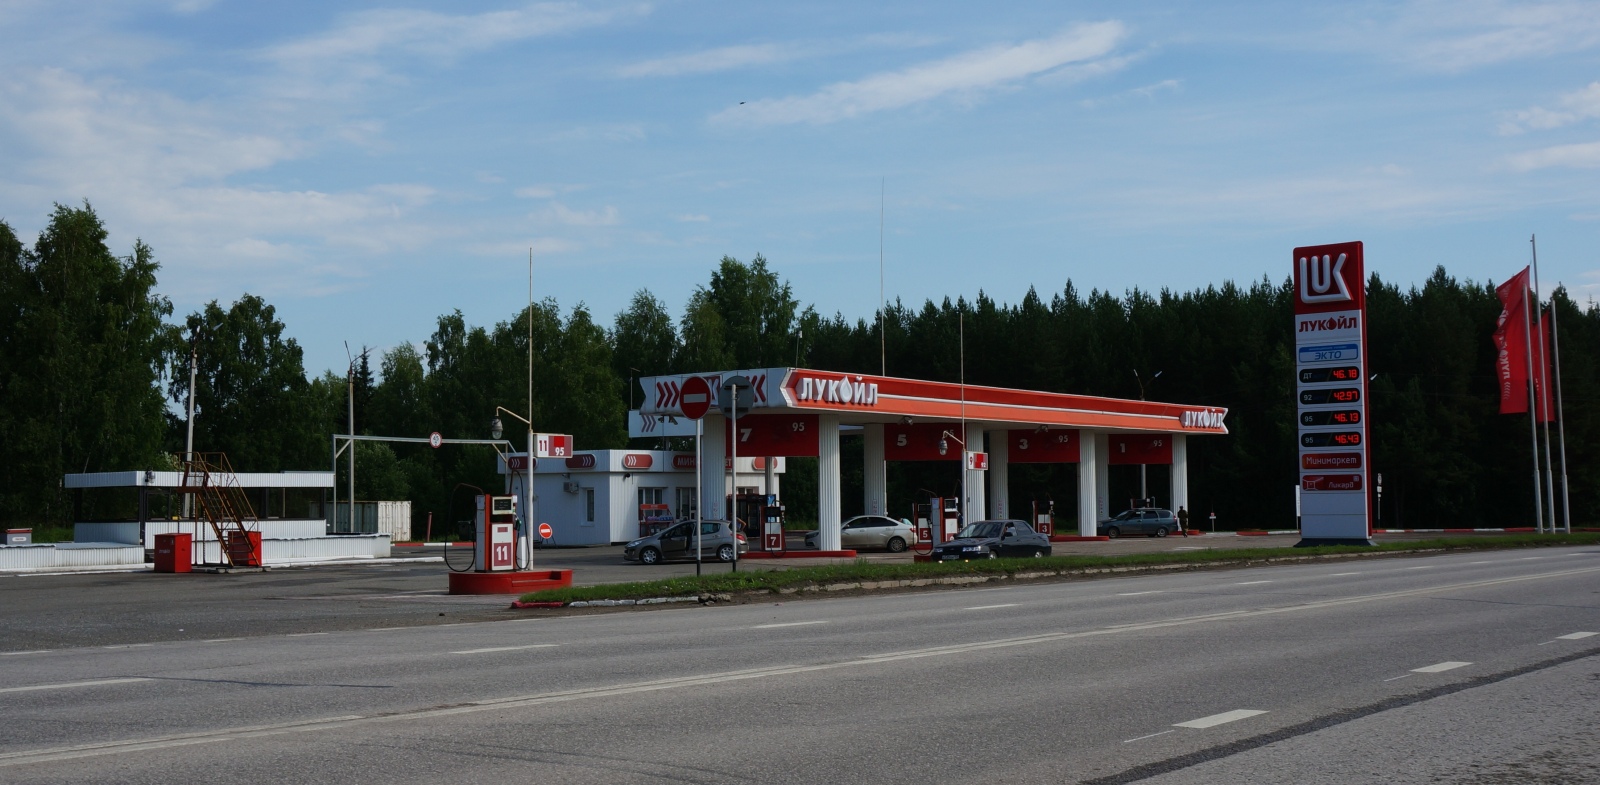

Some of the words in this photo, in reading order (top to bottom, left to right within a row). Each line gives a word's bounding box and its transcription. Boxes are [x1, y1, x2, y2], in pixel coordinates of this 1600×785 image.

[1299, 316, 1357, 333] ЛУКОЙЛ
[1314, 351, 1342, 360] ЭКТО
[1303, 372, 1313, 380] ДТ
[1333, 369, 1358, 379] 46.18
[800, 375, 878, 404] ЛУКОЙЛ
[1333, 391, 1358, 401] 42.97
[1184, 408, 1224, 429] ЛУКОЙЛ
[1334, 412, 1359, 422] 46.13
[792, 422, 805, 432] 95
[740, 428, 753, 442] 7
[1058, 434, 1069, 443] 95
[1335, 434, 1360, 444] 46.43
[897, 434, 907, 447] 5
[1019, 438, 1028, 450] 3
[1153, 439, 1163, 447] 95
[538, 440, 547, 452] 11
[1120, 443, 1126, 453] 1
[554, 447, 565, 456] 95
[969, 456, 974, 466] 9
[1306, 457, 1357, 466] Минимаркет
[1042, 524, 1048, 533] 3
[922, 531, 928, 539] 5
[770, 536, 777, 546] 7
[496, 545, 508, 561] 11
